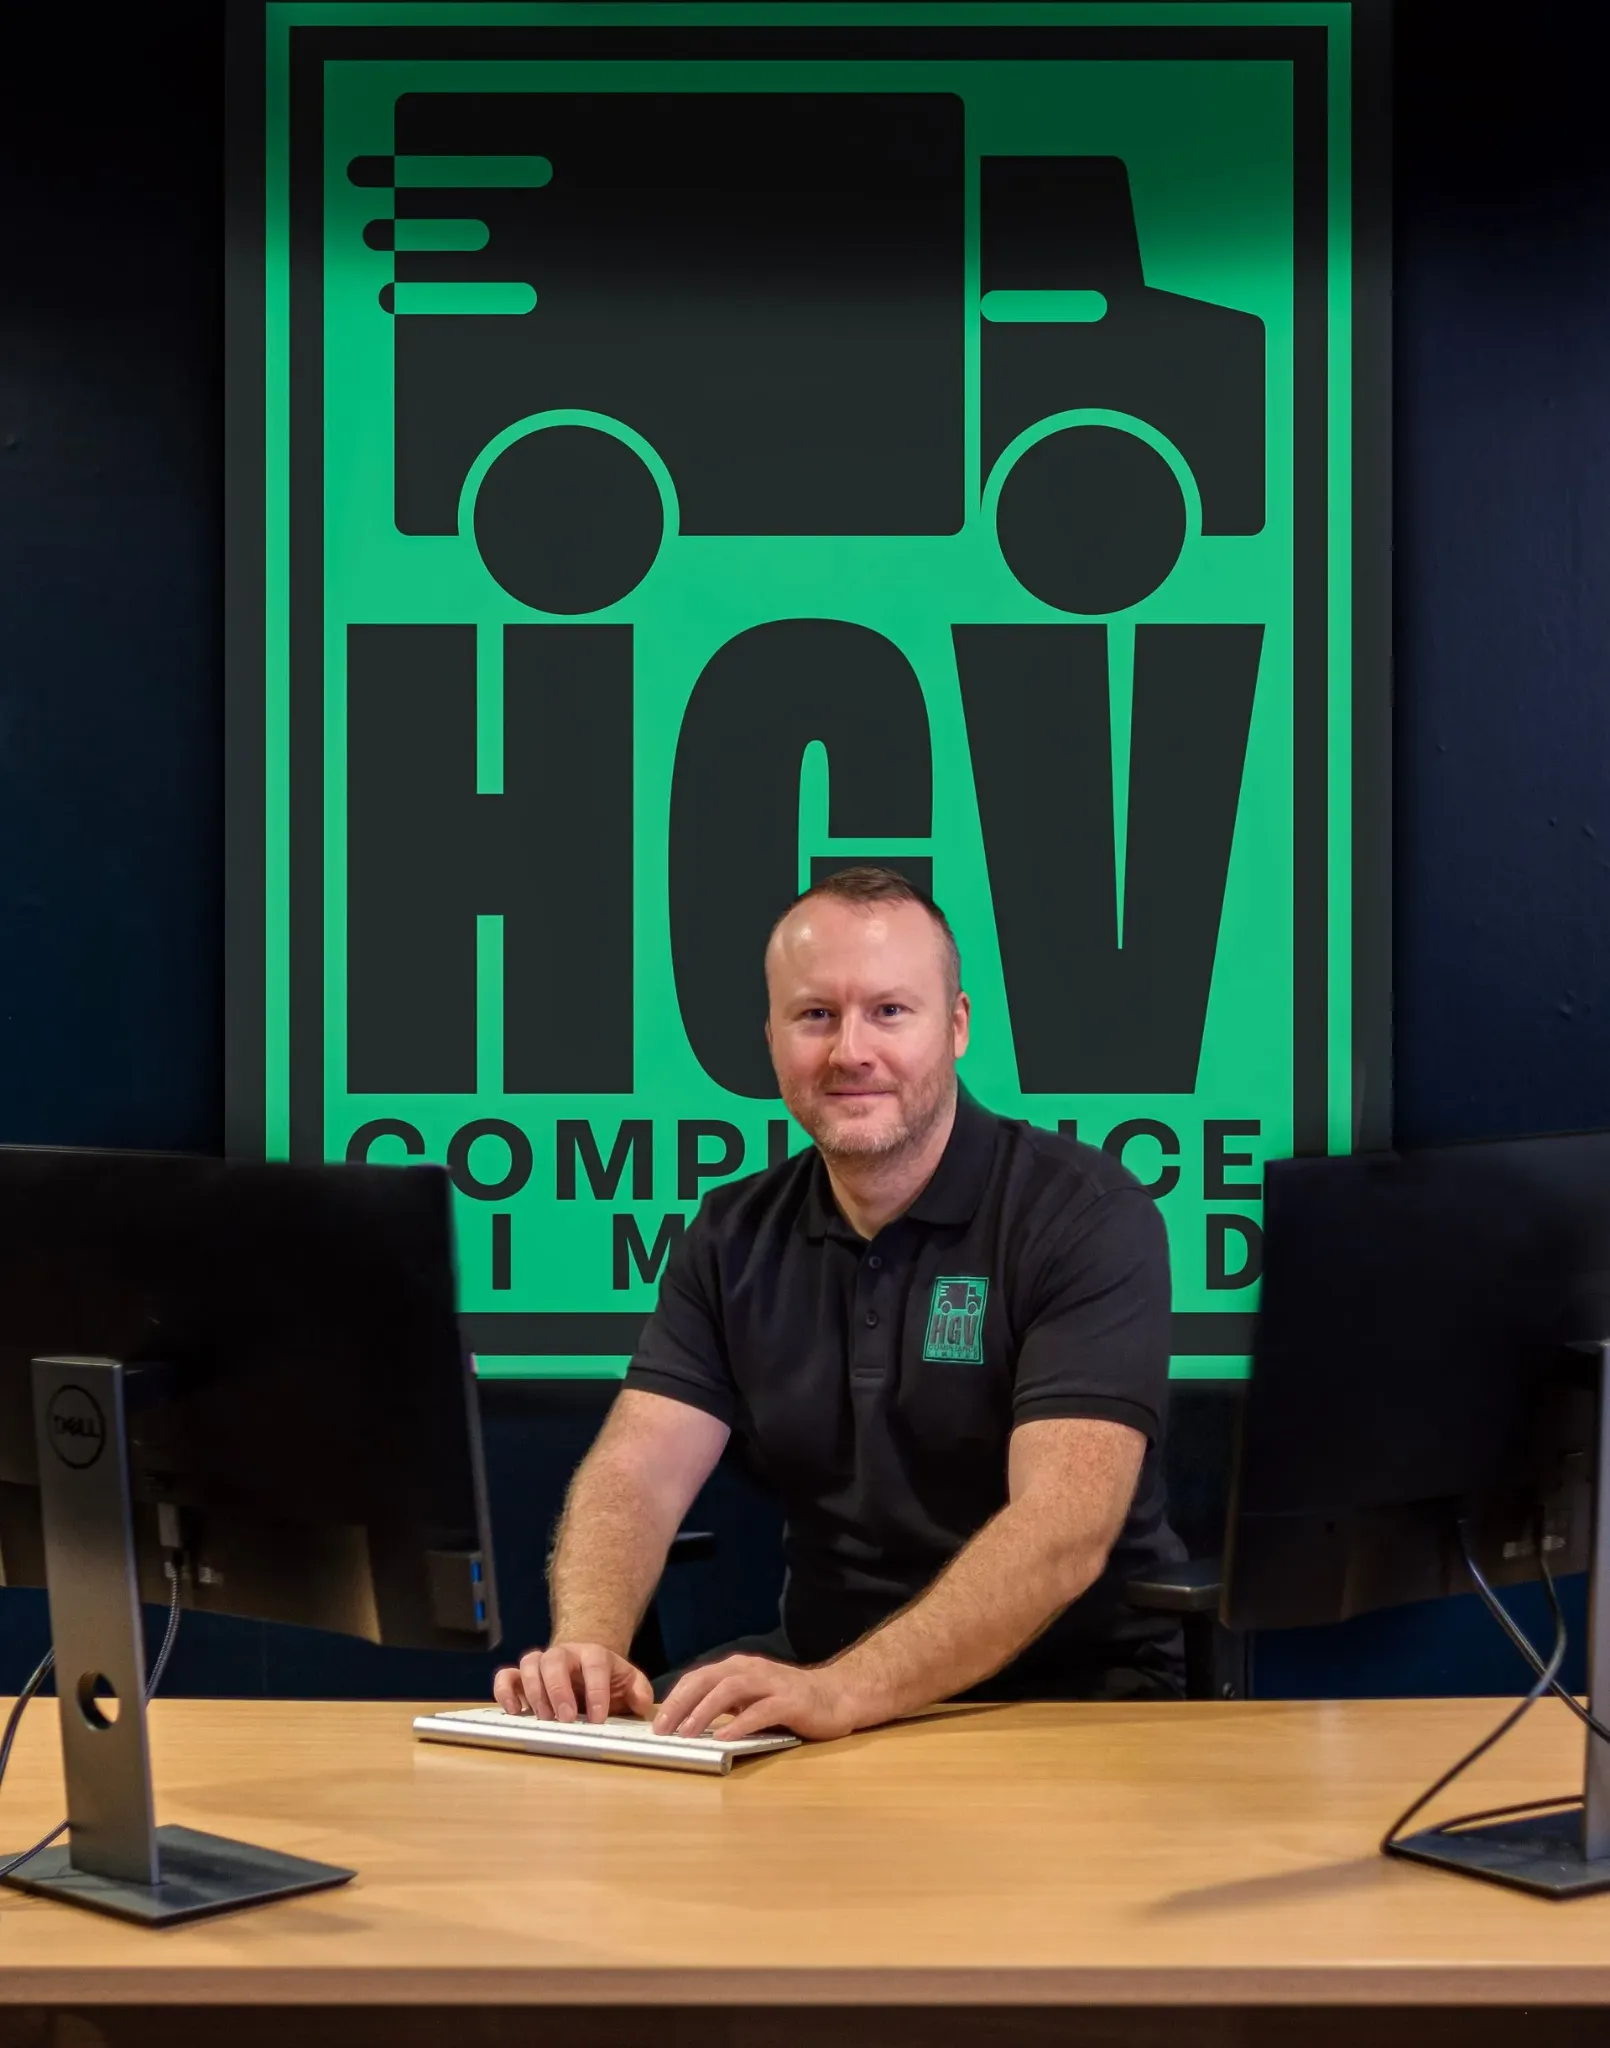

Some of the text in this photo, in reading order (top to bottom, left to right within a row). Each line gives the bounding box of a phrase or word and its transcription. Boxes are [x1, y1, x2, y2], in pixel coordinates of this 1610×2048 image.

[346, 617, 1266, 1100] HGV
[345, 1117, 1262, 1201] COMPCE
[929, 1313, 980, 1346] HGV
[53, 1415, 100, 1438] DELL
